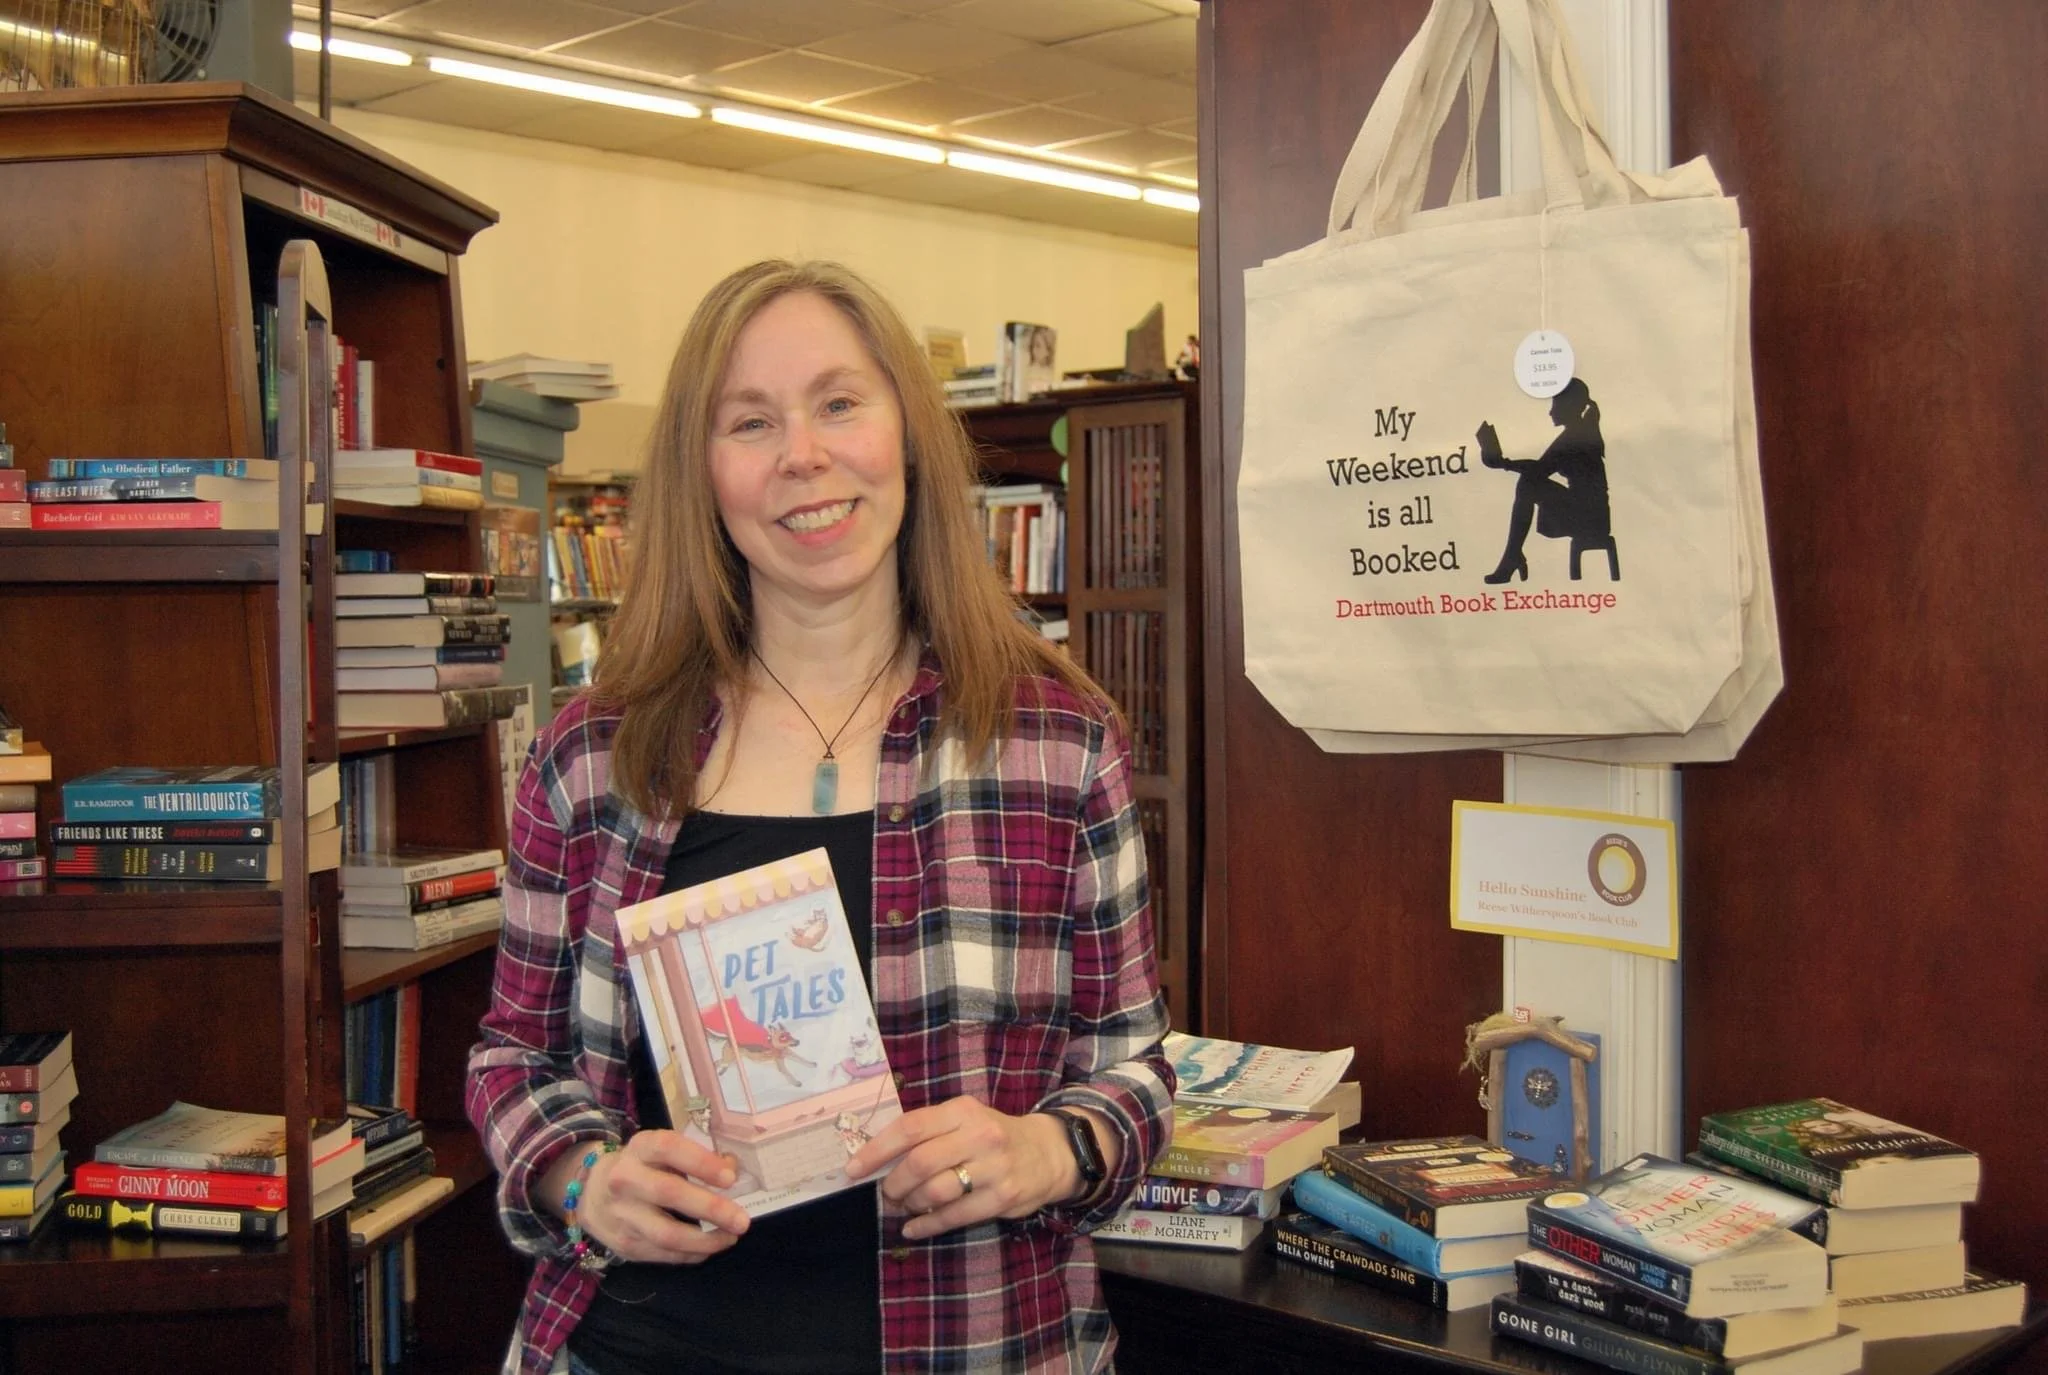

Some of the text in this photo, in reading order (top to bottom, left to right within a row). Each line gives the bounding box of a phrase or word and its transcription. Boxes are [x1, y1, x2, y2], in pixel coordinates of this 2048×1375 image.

[1374, 406, 1416, 441] My
[100, 463, 192, 474] An Obedient Father
[1326, 446, 1469, 486] Weekend
[35, 488, 51, 499] THE
[55, 486, 77, 498] LAST
[43, 512, 102, 523] Bachelor Girl
[1367, 495, 1433, 529] is all
[1350, 542, 1460, 576] Booked
[1335, 589, 1617, 618] Dartmouth Book Exchange
[144, 791, 250, 812] THE VENTRILOQUISTS
[58, 826, 164, 840] FRIENDS LIKE THESE
[1478, 880, 1587, 903] Hello Sunshine
[1477, 901, 1639, 929] Reese Witherspoon's Book Club
[724, 939, 779, 989] PET
[751, 967, 846, 1026] TALES
[1169, 1163, 1211, 1176] HELLER
[118, 1175, 210, 1198] GINNY MOON
[1152, 1185, 1199, 1206] DOYLE
[67, 1203, 102, 1219] GOLD
[1613, 1174, 1715, 1227] OTHER
[163, 1212, 236, 1227] CHRIS CLEAVE
[1101, 1221, 1128, 1233] cret
[1169, 1215, 1206, 1229] LIANE
[1154, 1226, 1219, 1241] MORIARTY
[1276, 1241, 1335, 1270] DELIA OWENS
[1276, 1229, 1416, 1286] WHERE THE CRAWDADS SING
[1531, 1223, 1637, 1274] THE OTHER WOMAN
[1558, 1288, 1605, 1312] dark wood
[1571, 1280, 1598, 1298] dark,
[1498, 1311, 1539, 1334] GONE
[1544, 1324, 1577, 1346] GIRL
[1581, 1336, 1689, 1375] GILLIAN FLYNN
